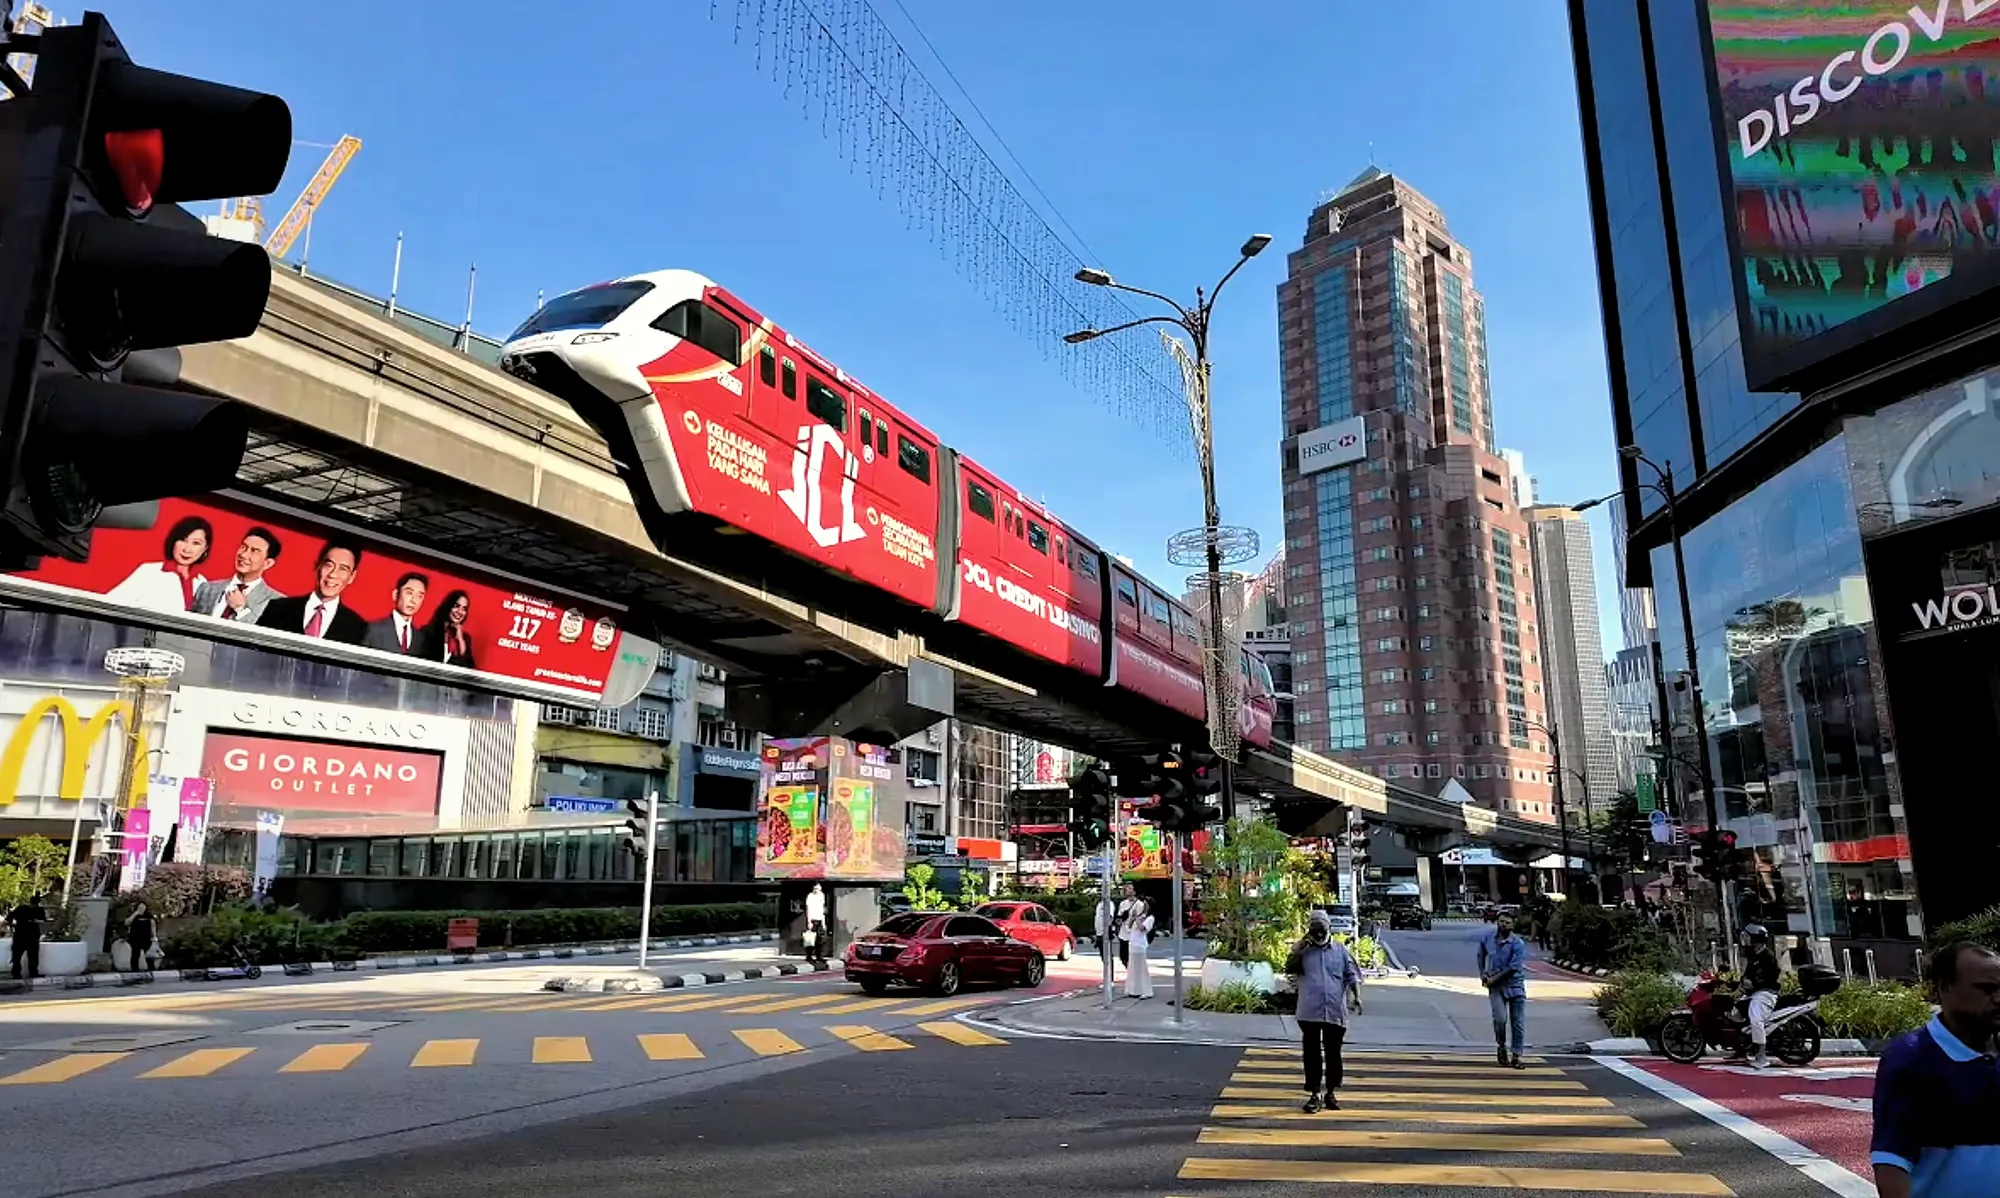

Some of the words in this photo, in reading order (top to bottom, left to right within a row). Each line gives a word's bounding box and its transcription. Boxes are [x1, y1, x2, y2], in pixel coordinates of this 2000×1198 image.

[706, 419, 768, 463] KELULUSAN
[707, 437, 740, 463] PADA
[739, 450, 765, 477] HARI
[1302, 440, 1337, 459] HSBC
[707, 451, 740, 480] YANG
[739, 465, 771, 495] SAMA
[963, 558, 994, 593] JCL
[995, 576, 1047, 619] CREDIT
[1047, 602, 1100, 644] LEASING
[497, 637, 519, 650] GREAT
[520, 641, 541, 654] YEARS
[509, 615, 541, 640] 117
[233, 702, 427, 740] GIORDANO
[223, 748, 418, 782] GIORDANO
[270, 778, 375, 796] OUTLET
